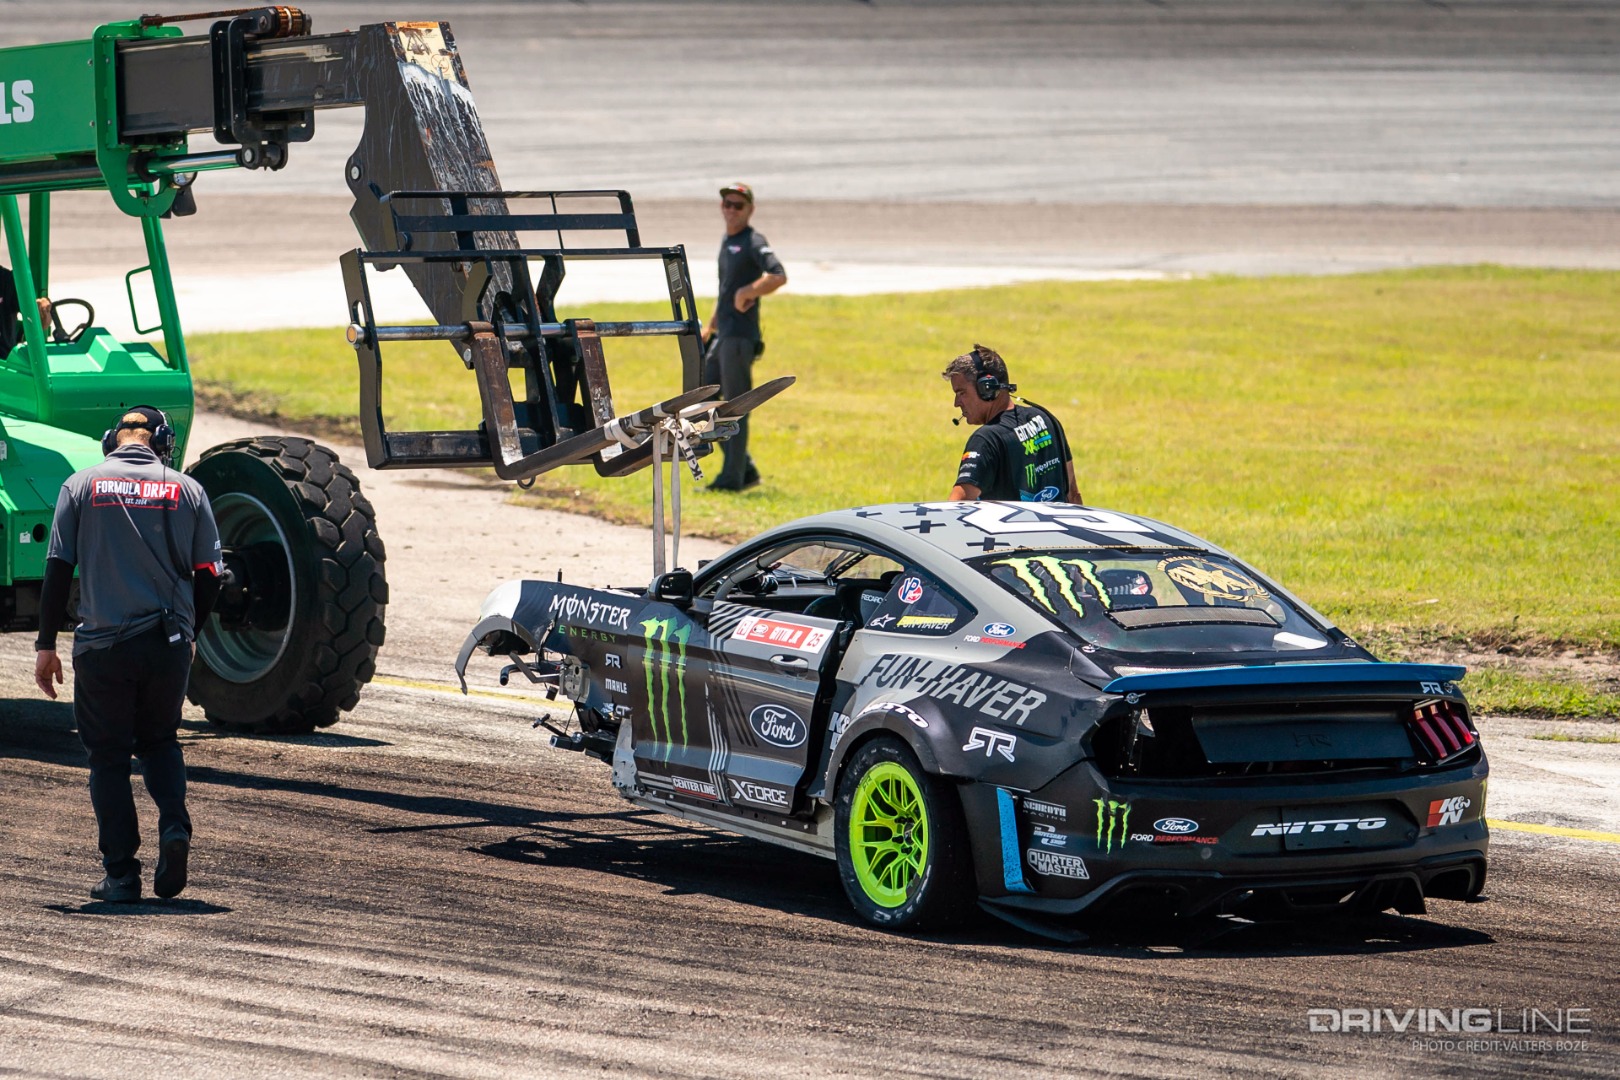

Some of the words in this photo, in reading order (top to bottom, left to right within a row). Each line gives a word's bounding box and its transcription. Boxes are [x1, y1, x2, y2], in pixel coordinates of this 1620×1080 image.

[95, 481, 141, 495] FORMULA
[558, 624, 616, 644] ENERGY
[806, 632, 824, 648] 25
[963, 635, 981, 643] FORD
[605, 678, 628, 695] MAHLE
[860, 654, 1047, 726] FUN-HAVER
[761, 709, 796, 743] Ford
[672, 777, 699, 792] CENTER
[699, 783, 716, 796] LINE
[1161, 819, 1191, 832] Ford
[1130, 833, 1154, 842] FORD
[1154, 834, 1220, 845] PERFORMANCE
[1029, 851, 1081, 868] QUARTER
[1038, 861, 1085, 877] MASTER
